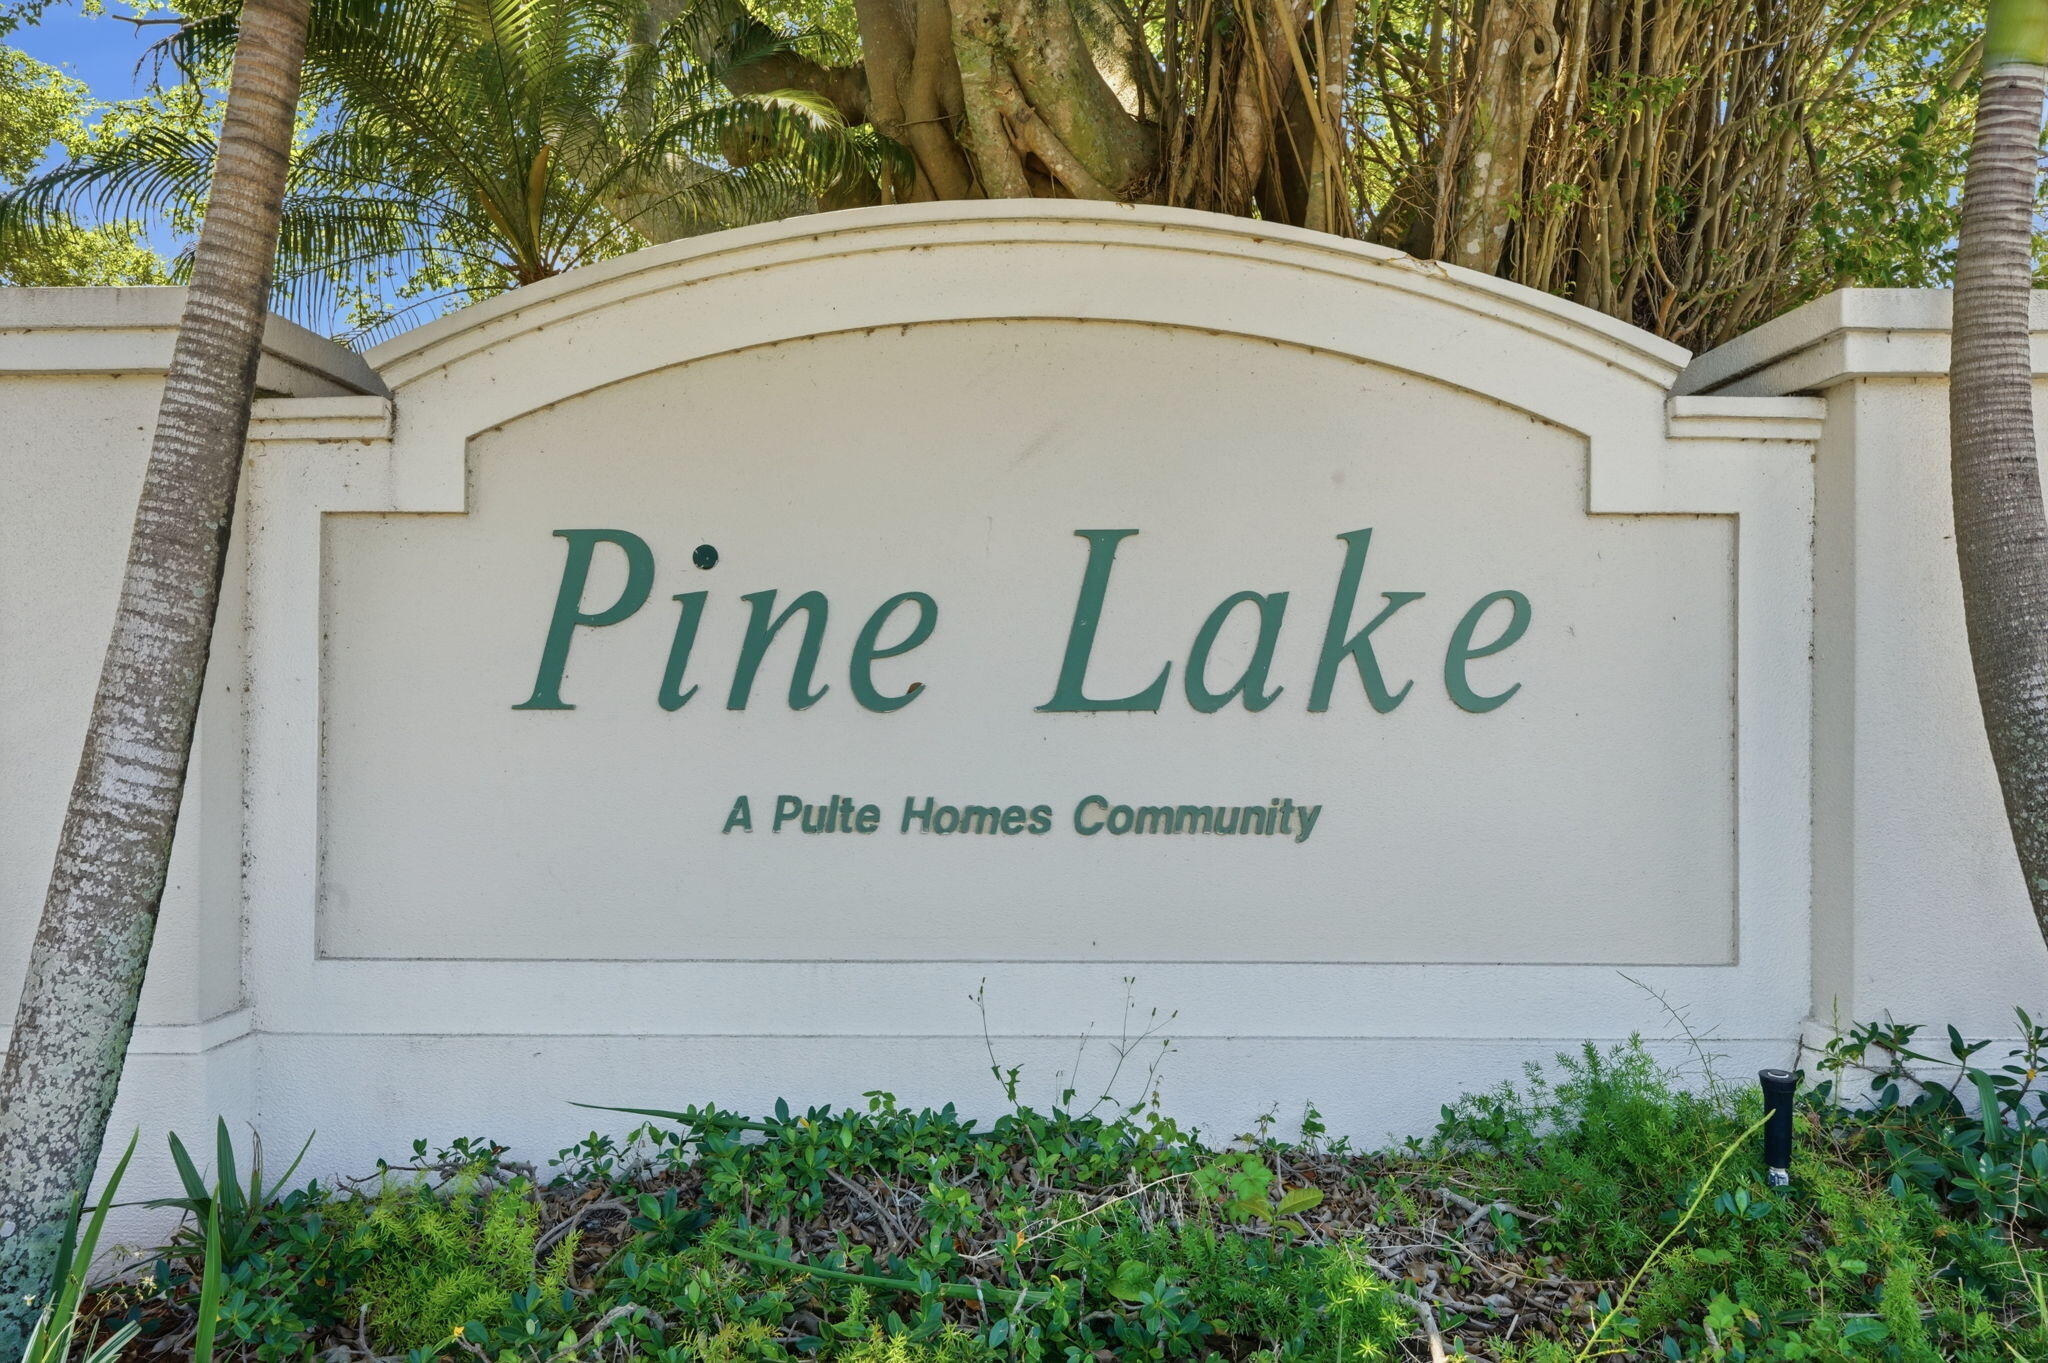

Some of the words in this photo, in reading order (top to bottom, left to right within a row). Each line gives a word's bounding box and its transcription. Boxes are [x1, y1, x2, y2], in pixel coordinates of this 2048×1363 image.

[511, 528, 939, 713] Pine
[1035, 527, 1532, 713] Lake
[721, 795, 753, 834] A
[772, 794, 881, 836] Pulte
[900, 796, 1053, 836] Homes
[1073, 794, 1324, 843] Community
